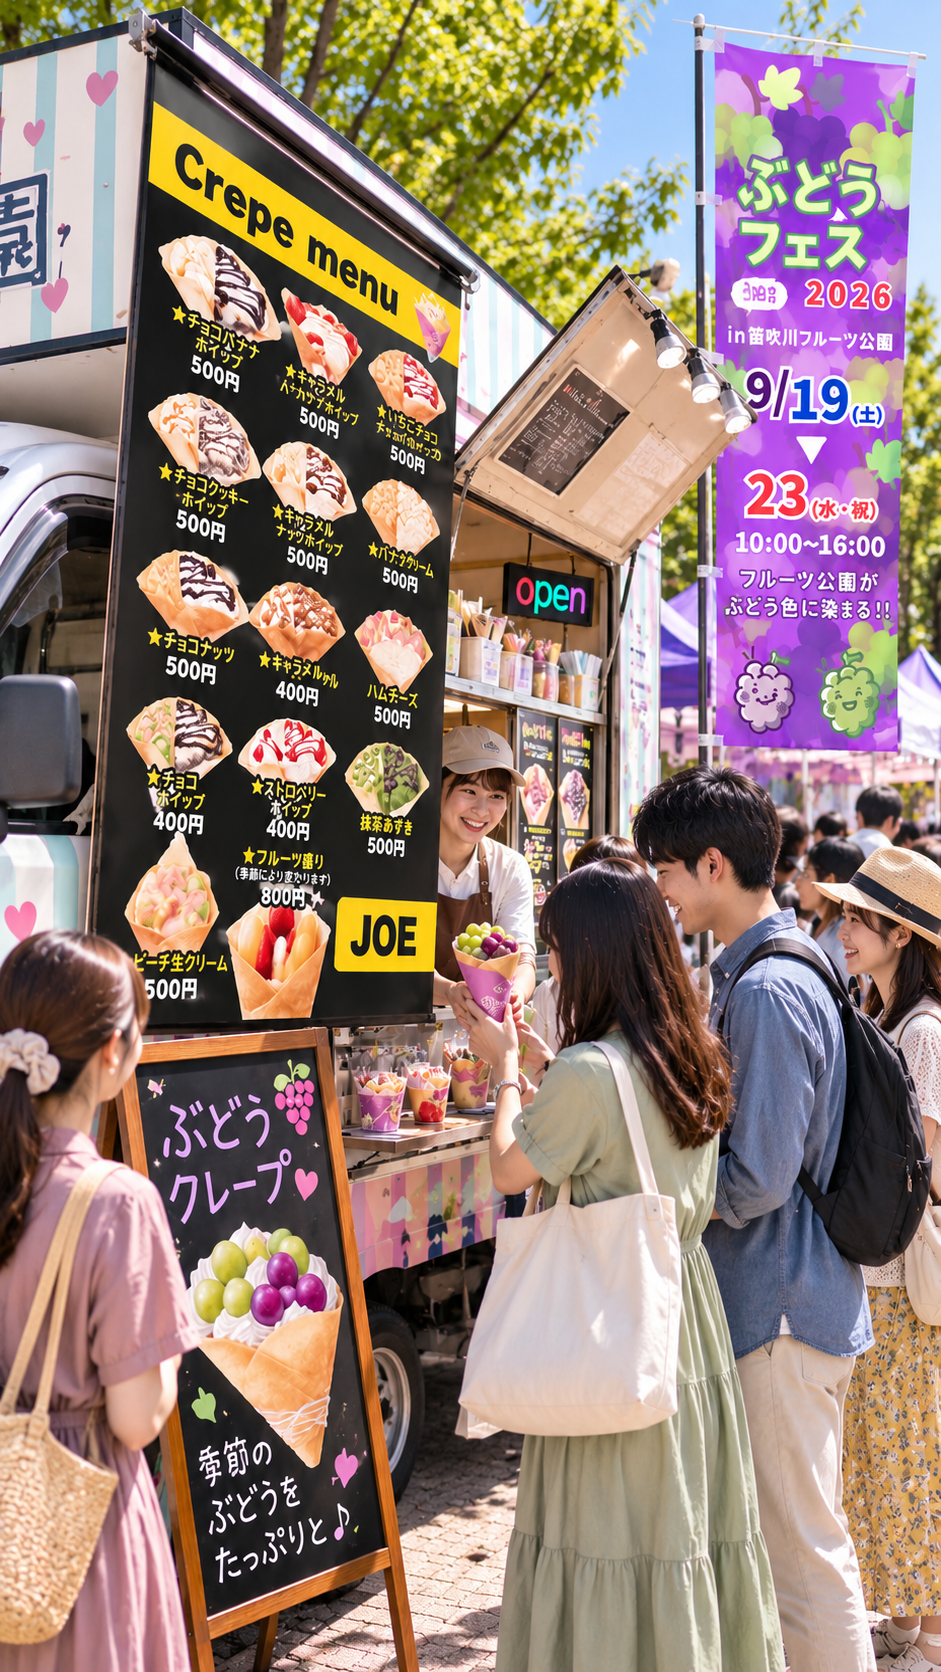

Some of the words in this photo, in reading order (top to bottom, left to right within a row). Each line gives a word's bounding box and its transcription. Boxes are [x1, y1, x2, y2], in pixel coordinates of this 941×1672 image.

[738, 157, 878, 219] ぶどう
[174, 142, 294, 249] Crepe
[307, 234, 399, 316] menu
[739, 220, 868, 272] フェス
[804, 279, 893, 311] 2026
[187, 313, 260, 359] チョコバナナ
[195, 336, 244, 369] ホイップ
[190, 354, 240, 394] 500円
[299, 406, 340, 440] 500円
[390, 444, 426, 475] 500円
[174, 468, 249, 505] チョコクッキー
[181, 491, 229, 518] ホイップ
[175, 508, 226, 543] 500円
[286, 545, 329, 576] 500円
[382, 566, 419, 594] 500円
[516, 576, 586, 615] open
[739, 569, 879, 593] フルーツ公園が
[163, 631, 235, 663] チョコナッツ
[165, 655, 217, 686] 500円
[275, 680, 320, 707] 400円
[373, 705, 412, 730] 500円
[161, 770, 198, 791] チョコ
[156, 789, 206, 811] ホイップ
[152, 810, 204, 835] 400円
[266, 819, 311, 841] 400円
[359, 813, 413, 836] 抹茶あずき
[367, 836, 406, 858] 500円
[260, 886, 306, 908] 800円
[350, 914, 417, 957] JOE
[144, 978, 198, 1000] 500円
[162, 1094, 270, 1158] ぶどう
[169, 1148, 292, 1225] クレープ
[198, 1436, 273, 1488] 季節の
[208, 1475, 301, 1536] ぶどうを
